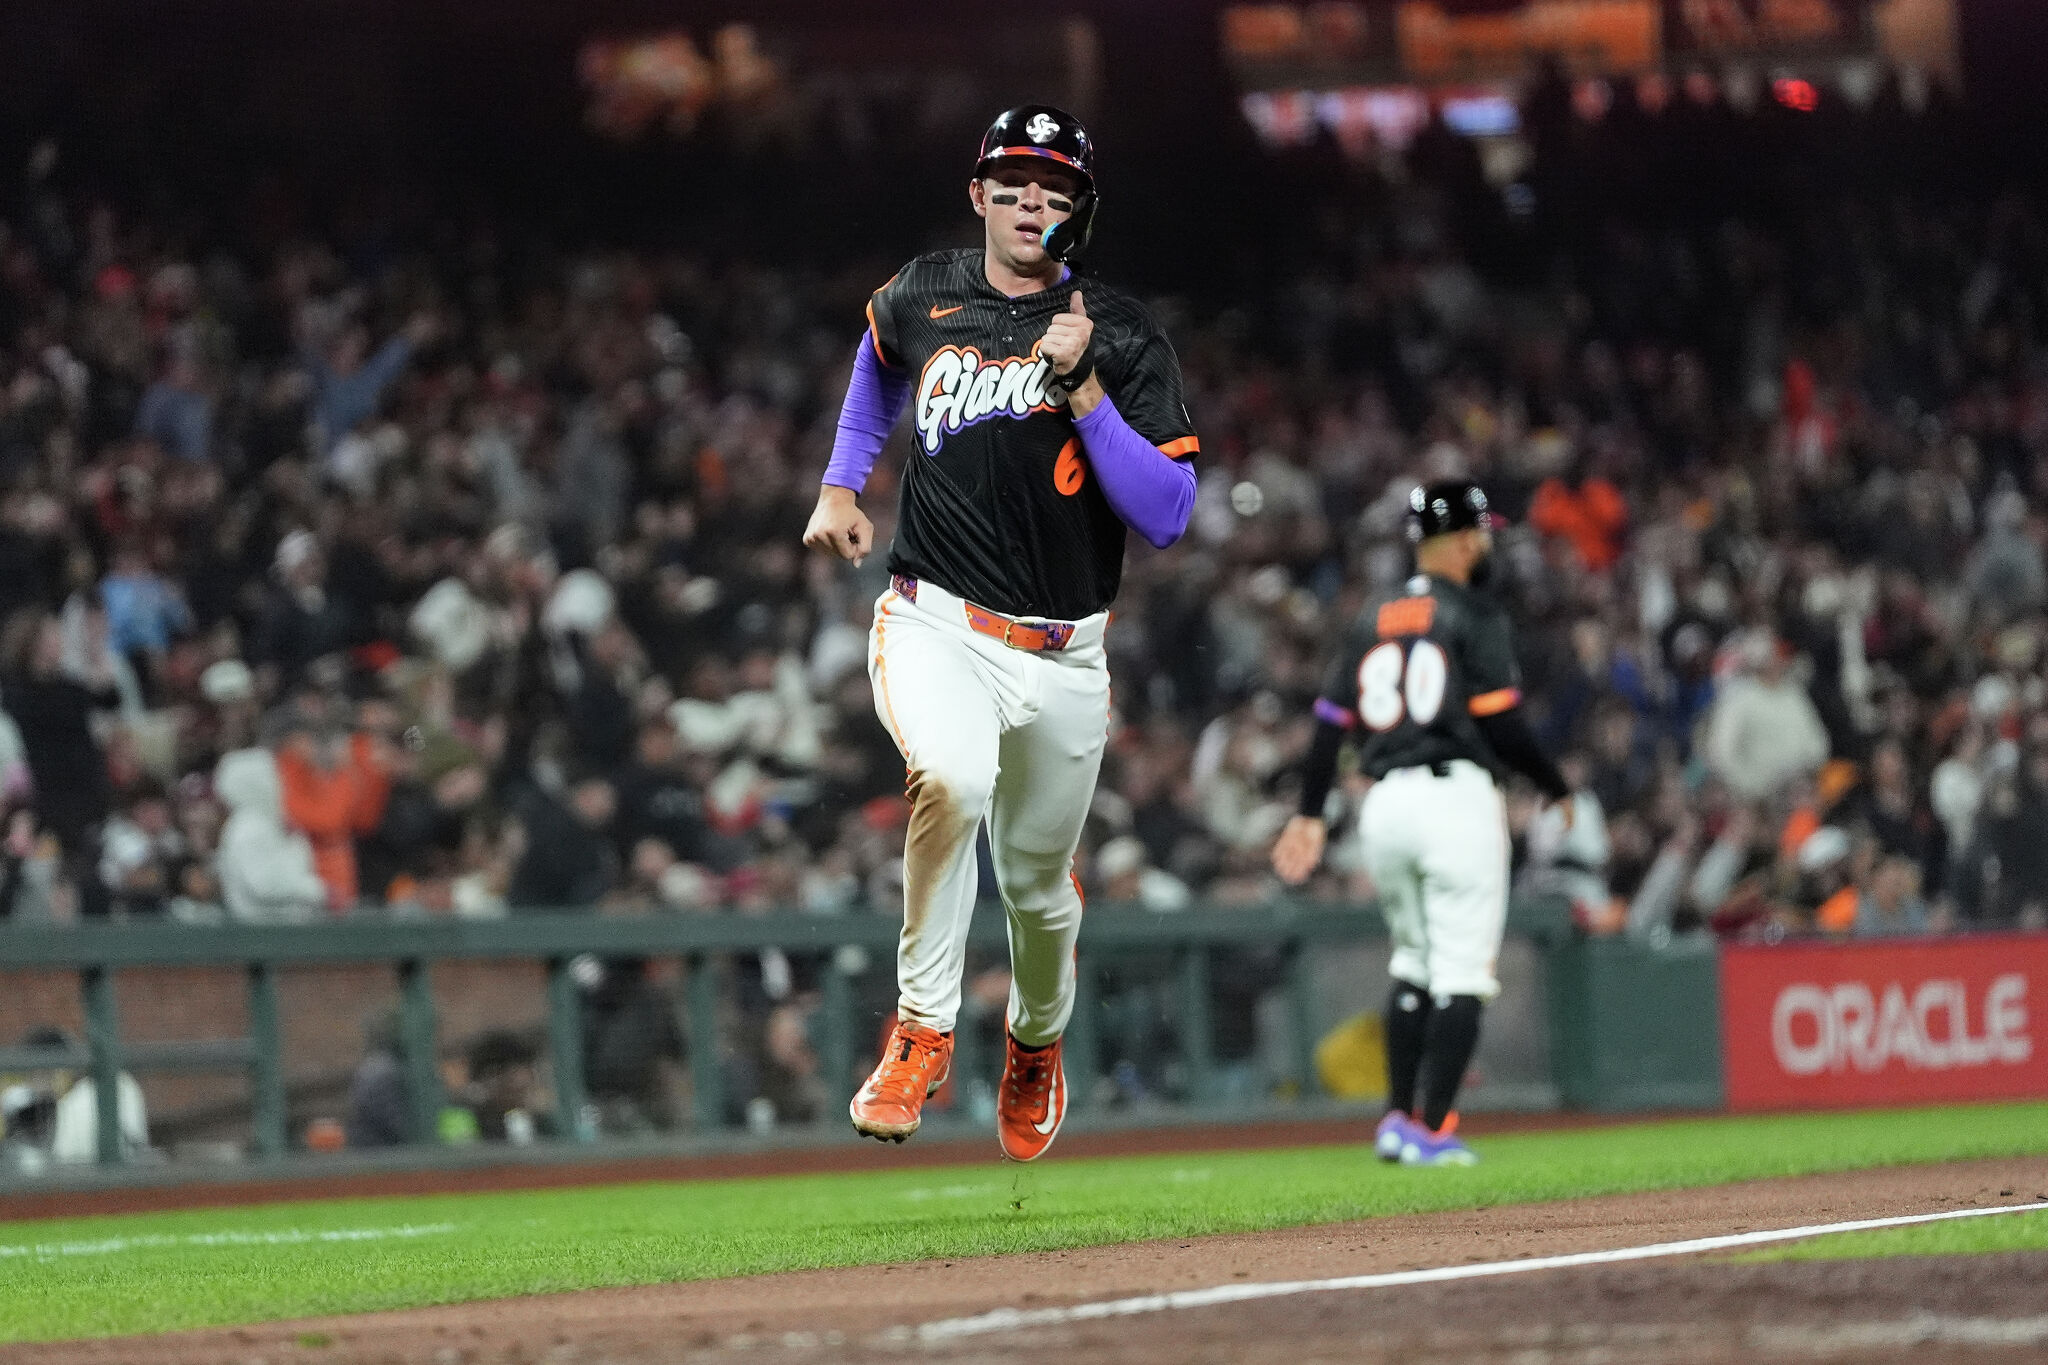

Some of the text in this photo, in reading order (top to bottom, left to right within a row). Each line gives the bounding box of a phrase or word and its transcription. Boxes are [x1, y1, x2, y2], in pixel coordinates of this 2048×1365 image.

[1053, 436, 1087, 496] 6
[1358, 637, 1449, 733] 80
[1772, 974, 2032, 1075] ORACLE
